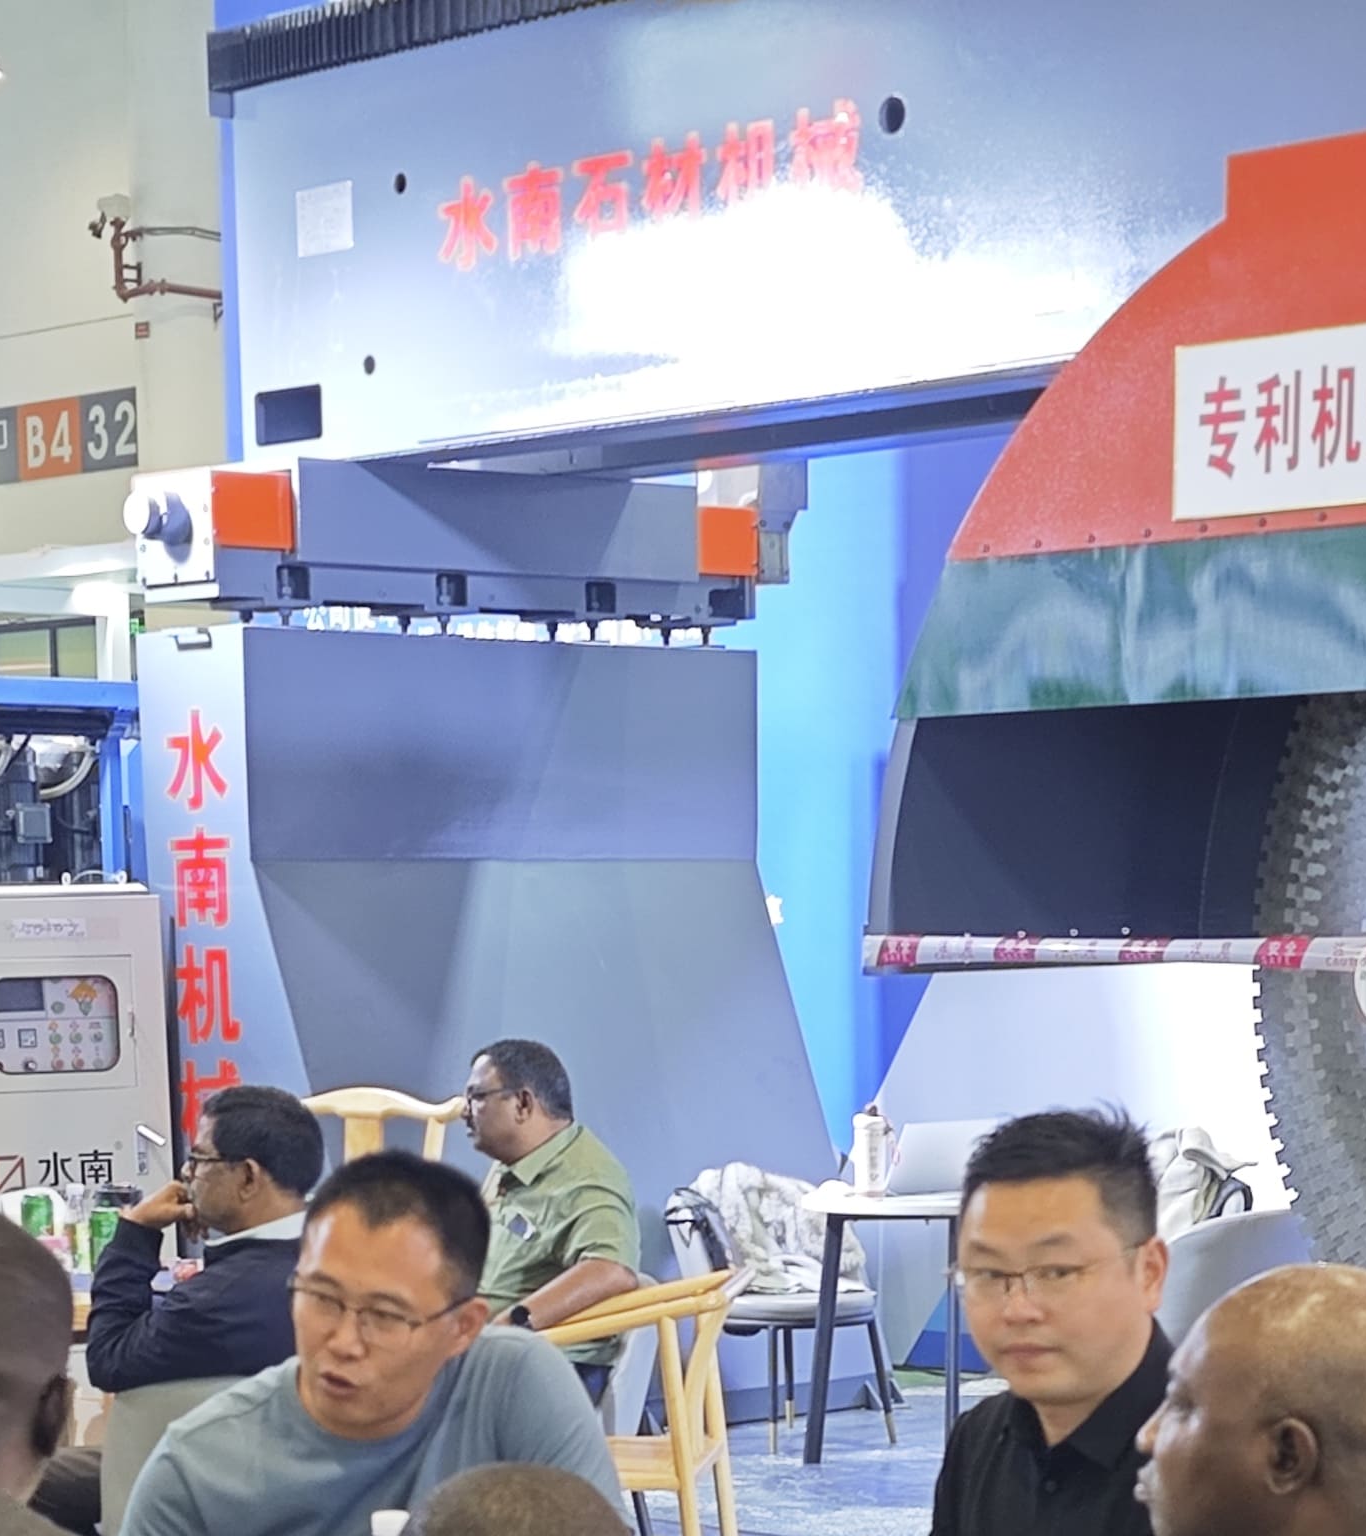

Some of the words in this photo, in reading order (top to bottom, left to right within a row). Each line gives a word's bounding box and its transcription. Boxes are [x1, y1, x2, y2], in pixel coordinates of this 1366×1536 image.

[439, 98, 865, 271] 水南石材机械
[26, 410, 73, 469] B4
[87, 400, 137, 460] 32
[38, 1149, 114, 1187] 水南
